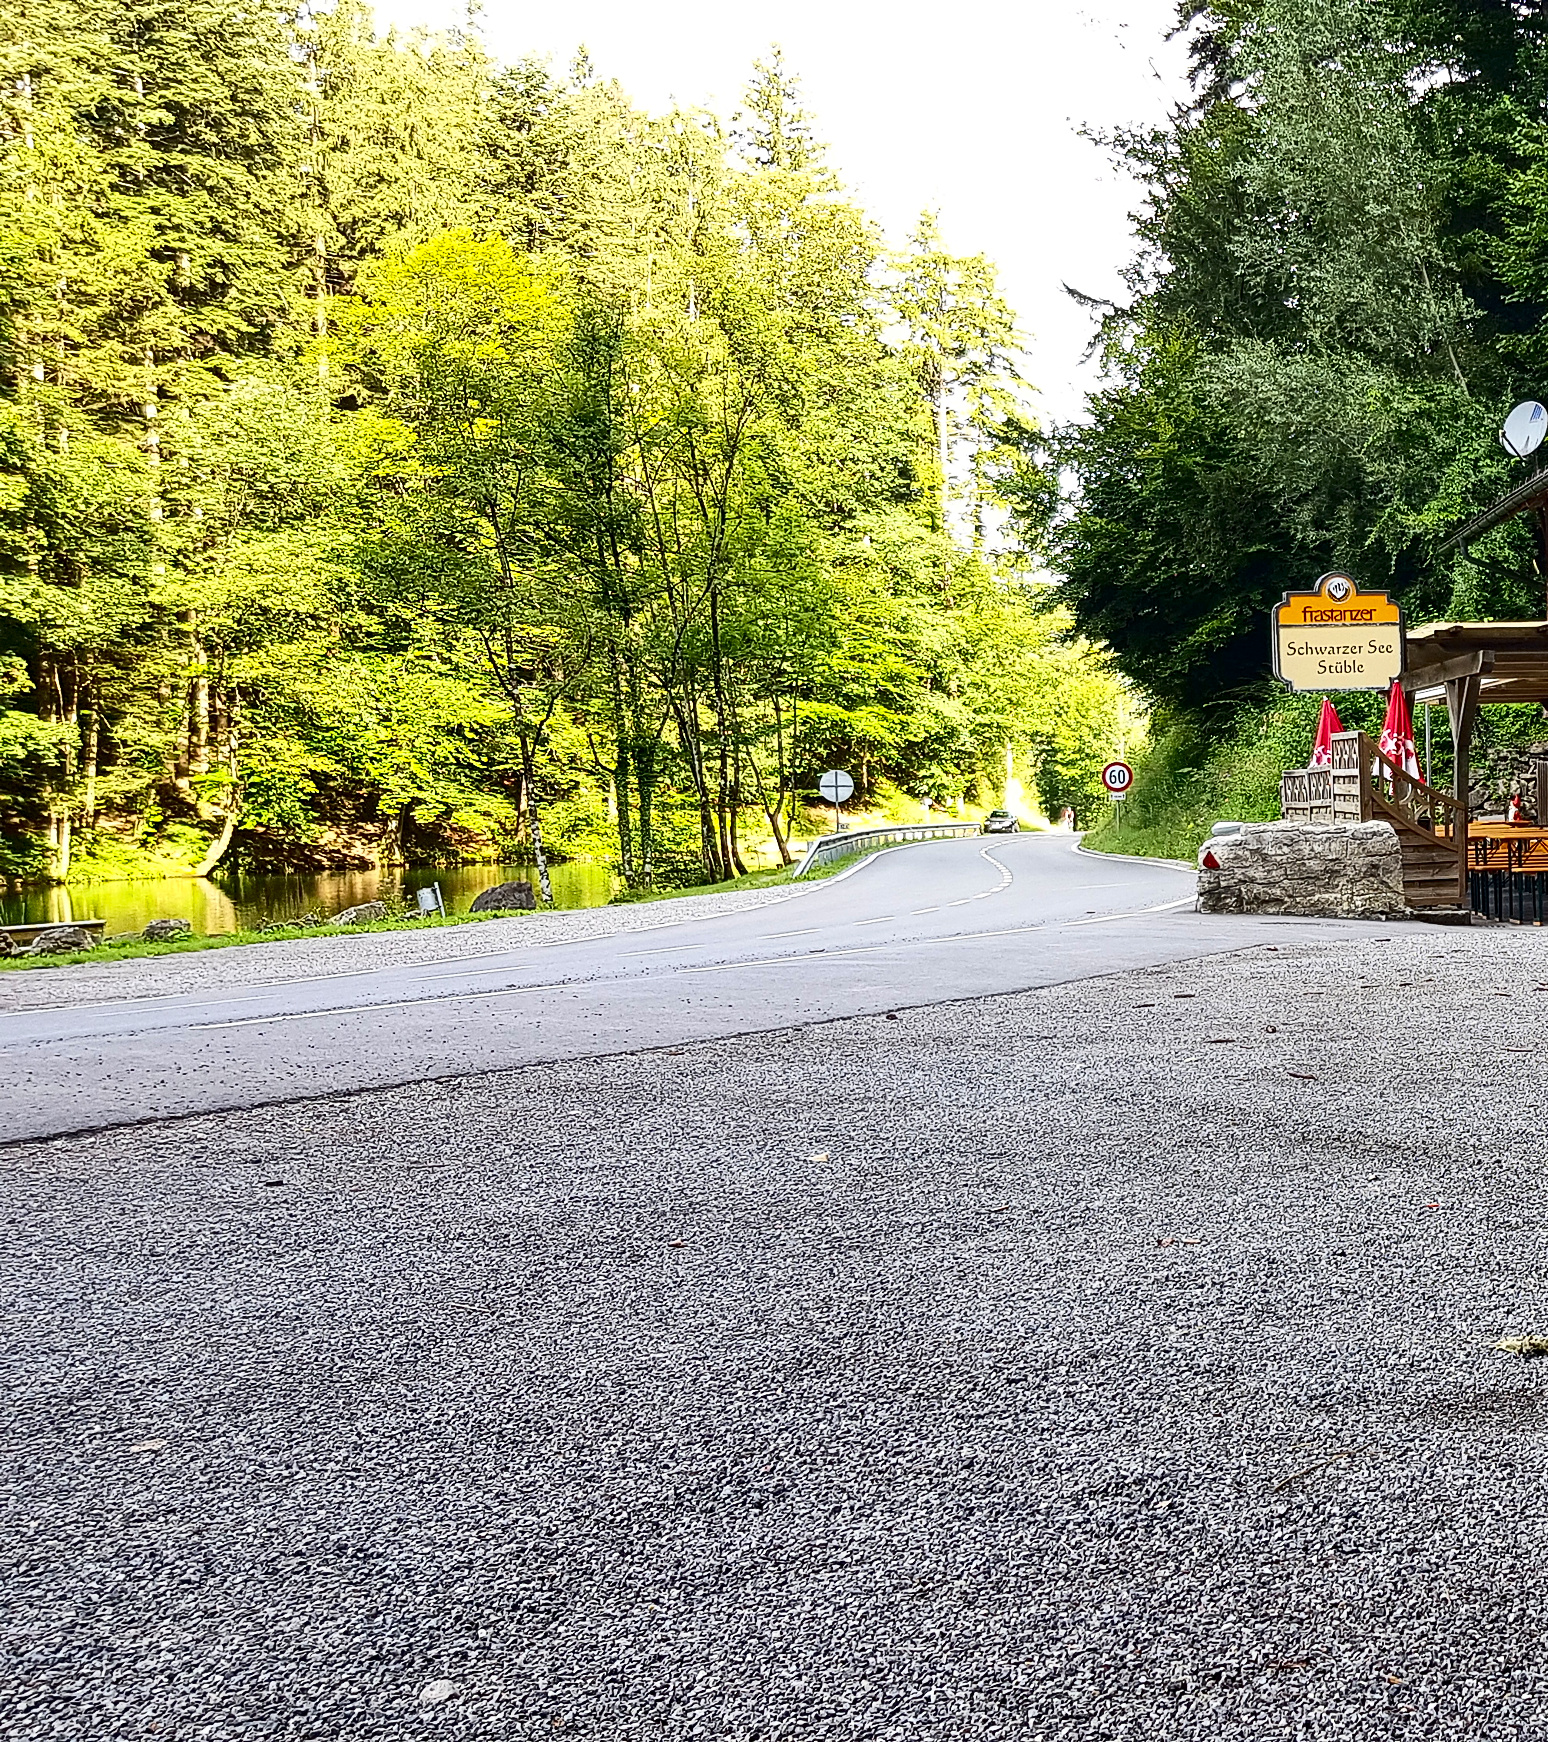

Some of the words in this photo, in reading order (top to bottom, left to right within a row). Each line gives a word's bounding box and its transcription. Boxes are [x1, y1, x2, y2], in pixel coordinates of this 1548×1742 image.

[1286, 641, 1364, 656] Schwarzer
[1367, 639, 1394, 655] See
[1317, 659, 1365, 675] Stüble
[1109, 769, 1125, 784] 60
